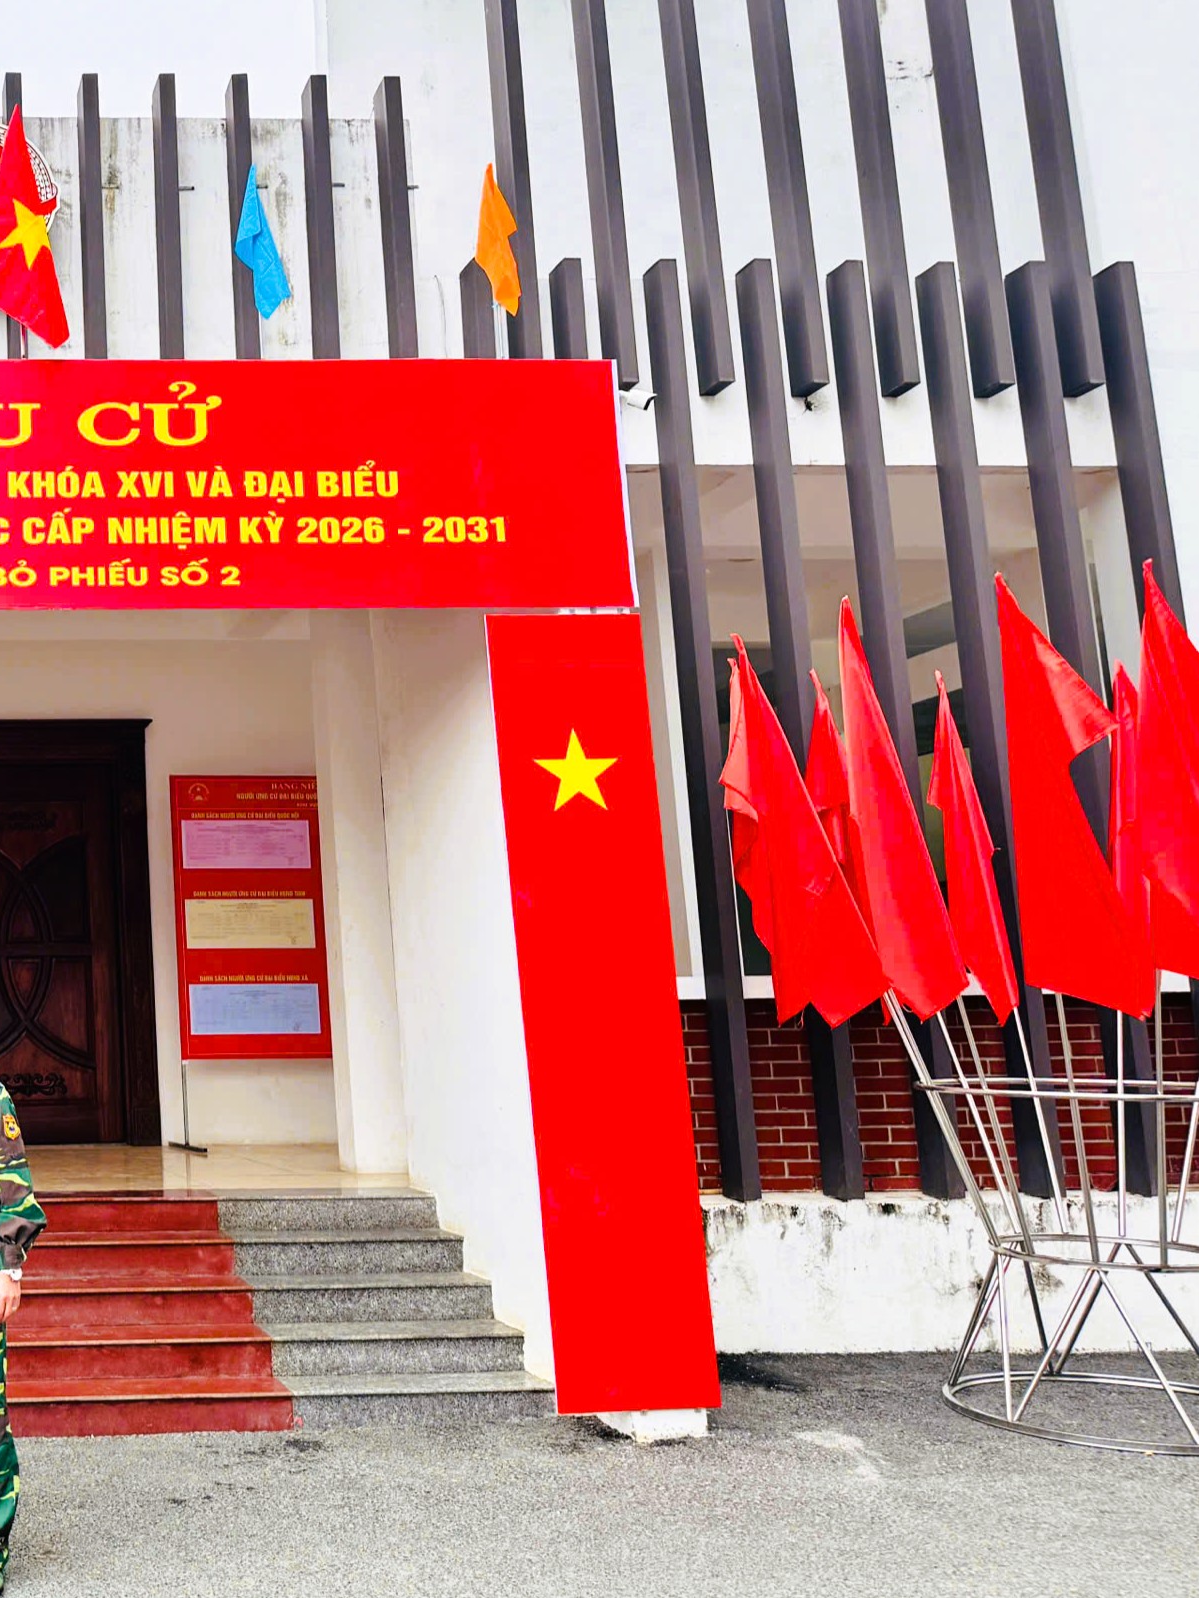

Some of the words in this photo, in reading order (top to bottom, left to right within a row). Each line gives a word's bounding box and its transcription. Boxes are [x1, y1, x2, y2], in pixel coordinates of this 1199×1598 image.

[77, 382, 222, 447] CỬ
[8, 466, 105, 498] KHÓA
[118, 472, 174, 497] XVI
[186, 466, 232, 497] VÀ
[244, 471, 303, 502] ĐẠI
[317, 460, 399, 497] BIỂU
[23, 508, 94, 544] CẤP
[108, 512, 226, 549] NHIỆM
[240, 511, 283, 543] KỲ
[298, 517, 384, 543] 2026
[423, 517, 506, 542] 2031
[50, 559, 147, 586] PHIẾU
[161, 558, 208, 585] SỐ
[221, 566, 240, 585] 2
